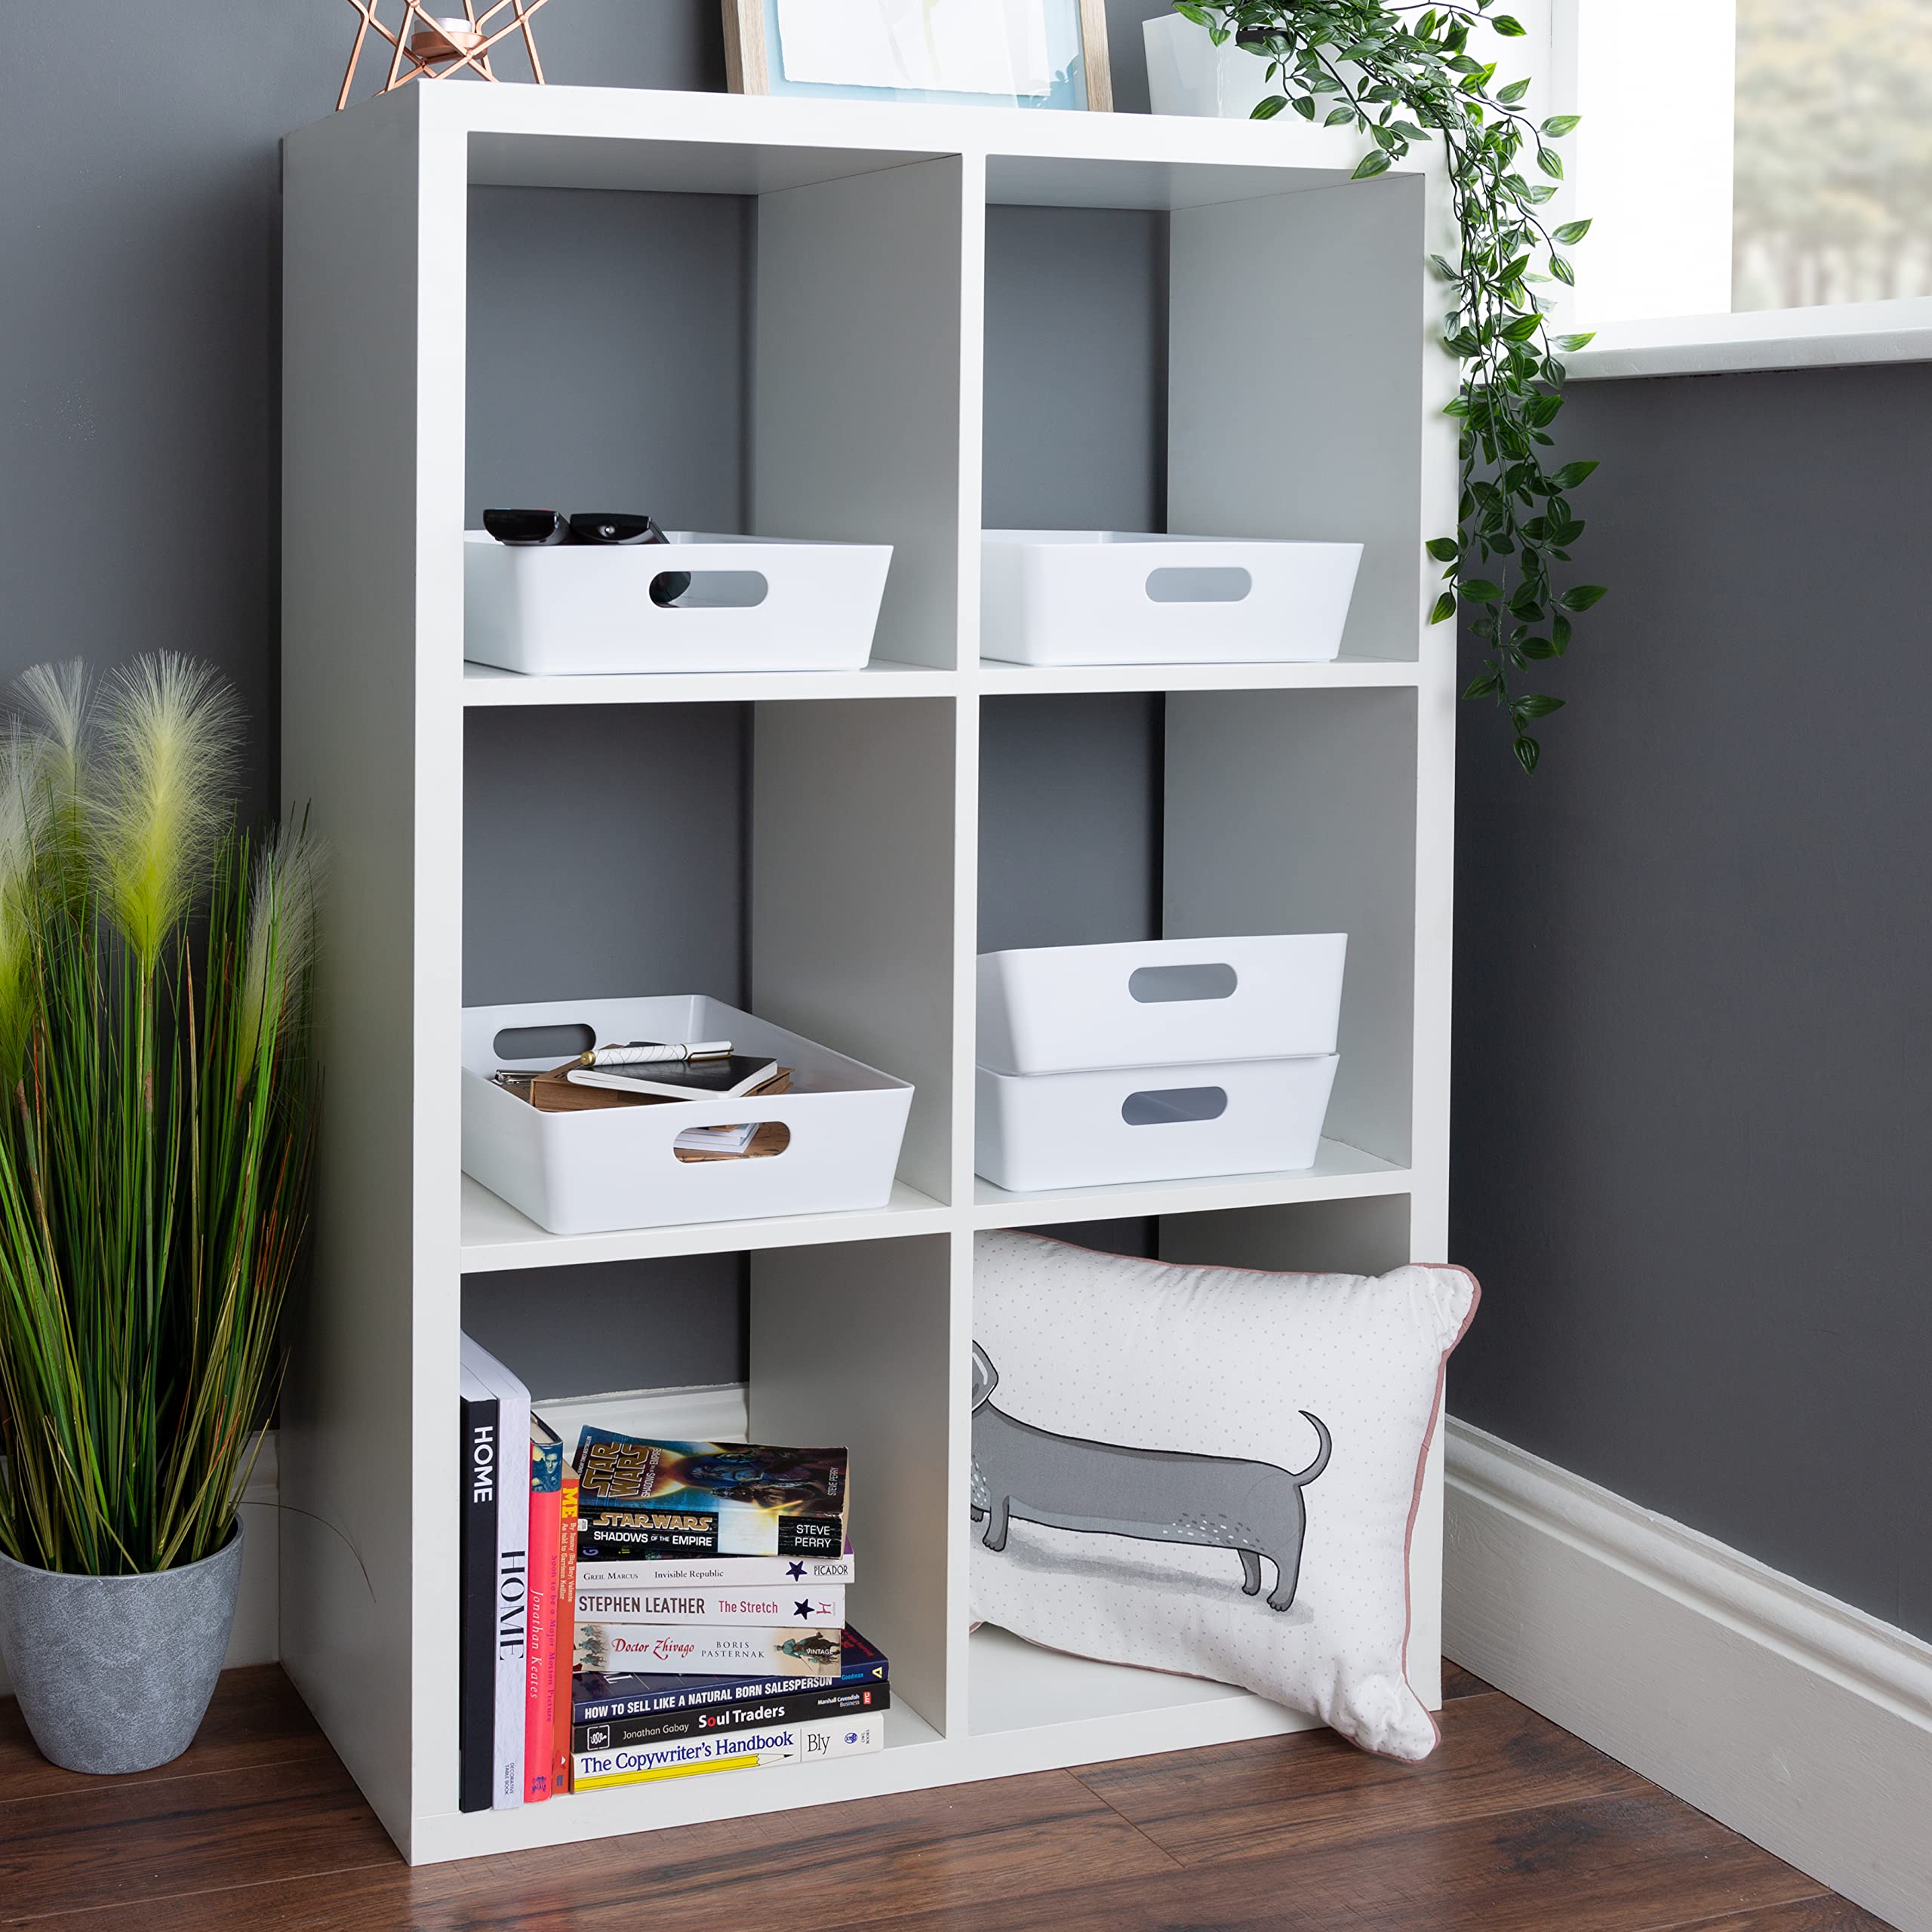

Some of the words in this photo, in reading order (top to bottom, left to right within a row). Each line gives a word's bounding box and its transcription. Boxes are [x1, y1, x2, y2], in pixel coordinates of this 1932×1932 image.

[473, 1426, 494, 1503] HOME
[582, 1441, 622, 1497] STAR
[608, 1443, 649, 1497] WARS
[641, 1473, 656, 1498] SHADOWS
[649, 1448, 661, 1465] EMPIRE
[829, 1467, 839, 1481] PERRY
[828, 1481, 838, 1497] STEVE
[561, 1487, 578, 1518] ME
[561, 1523, 568, 1531] As
[569, 1522, 577, 1531] By
[592, 1512, 654, 1528] STAR
[651, 1514, 712, 1531] WARS
[796, 1524, 830, 1535] STEVE
[593, 1531, 648, 1543] SHADOWS
[672, 1535, 712, 1547] EMPIRE
[795, 1537, 832, 1548] PERRY
[583, 1572, 605, 1581] GREIL
[608, 1571, 638, 1580] MARCUS
[654, 1571, 688, 1579] Invisible
[689, 1569, 724, 1580] Republic
[814, 1564, 849, 1576] PICADOR
[550, 1582, 556, 1592] to
[500, 1551, 525, 1660] HOME
[549, 1594, 557, 1605] be
[579, 1595, 641, 1613] STEPHEN
[645, 1597, 706, 1614] LEATHER
[718, 1600, 737, 1614] The
[740, 1601, 778, 1614] Stretch
[530, 1587, 544, 1650] Jonathan
[546, 1620, 556, 1647] Major
[611, 1637, 650, 1653] Doctor
[653, 1636, 694, 1660] Zhivago
[701, 1650, 765, 1659] PASTERNAK
[716, 1641, 749, 1649] BORIS
[530, 1656, 543, 1699] Keates
[841, 1672, 864, 1681] Goodman
[546, 1689, 555, 1722] Picture
[585, 1706, 608, 1720] HOW
[611, 1703, 625, 1715] TO
[627, 1701, 651, 1714] SELL
[654, 1697, 675, 1710] LIKE
[678, 1695, 686, 1706] A
[688, 1689, 733, 1706] NATURAL
[735, 1684, 762, 1699] BORN
[764, 1676, 832, 1695] SALESPERSON
[817, 1697, 837, 1706] Marshall
[837, 1694, 860, 1703] Cavendish
[623, 1727, 661, 1740] Jonathan
[663, 1724, 689, 1733] Gabay
[698, 1711, 730, 1729] Soul
[732, 1706, 786, 1723] Traders
[581, 1756, 612, 1774] The
[615, 1742, 712, 1771] Copywriter's
[715, 1730, 794, 1756] Handbook
[807, 1734, 831, 1755] Bly
